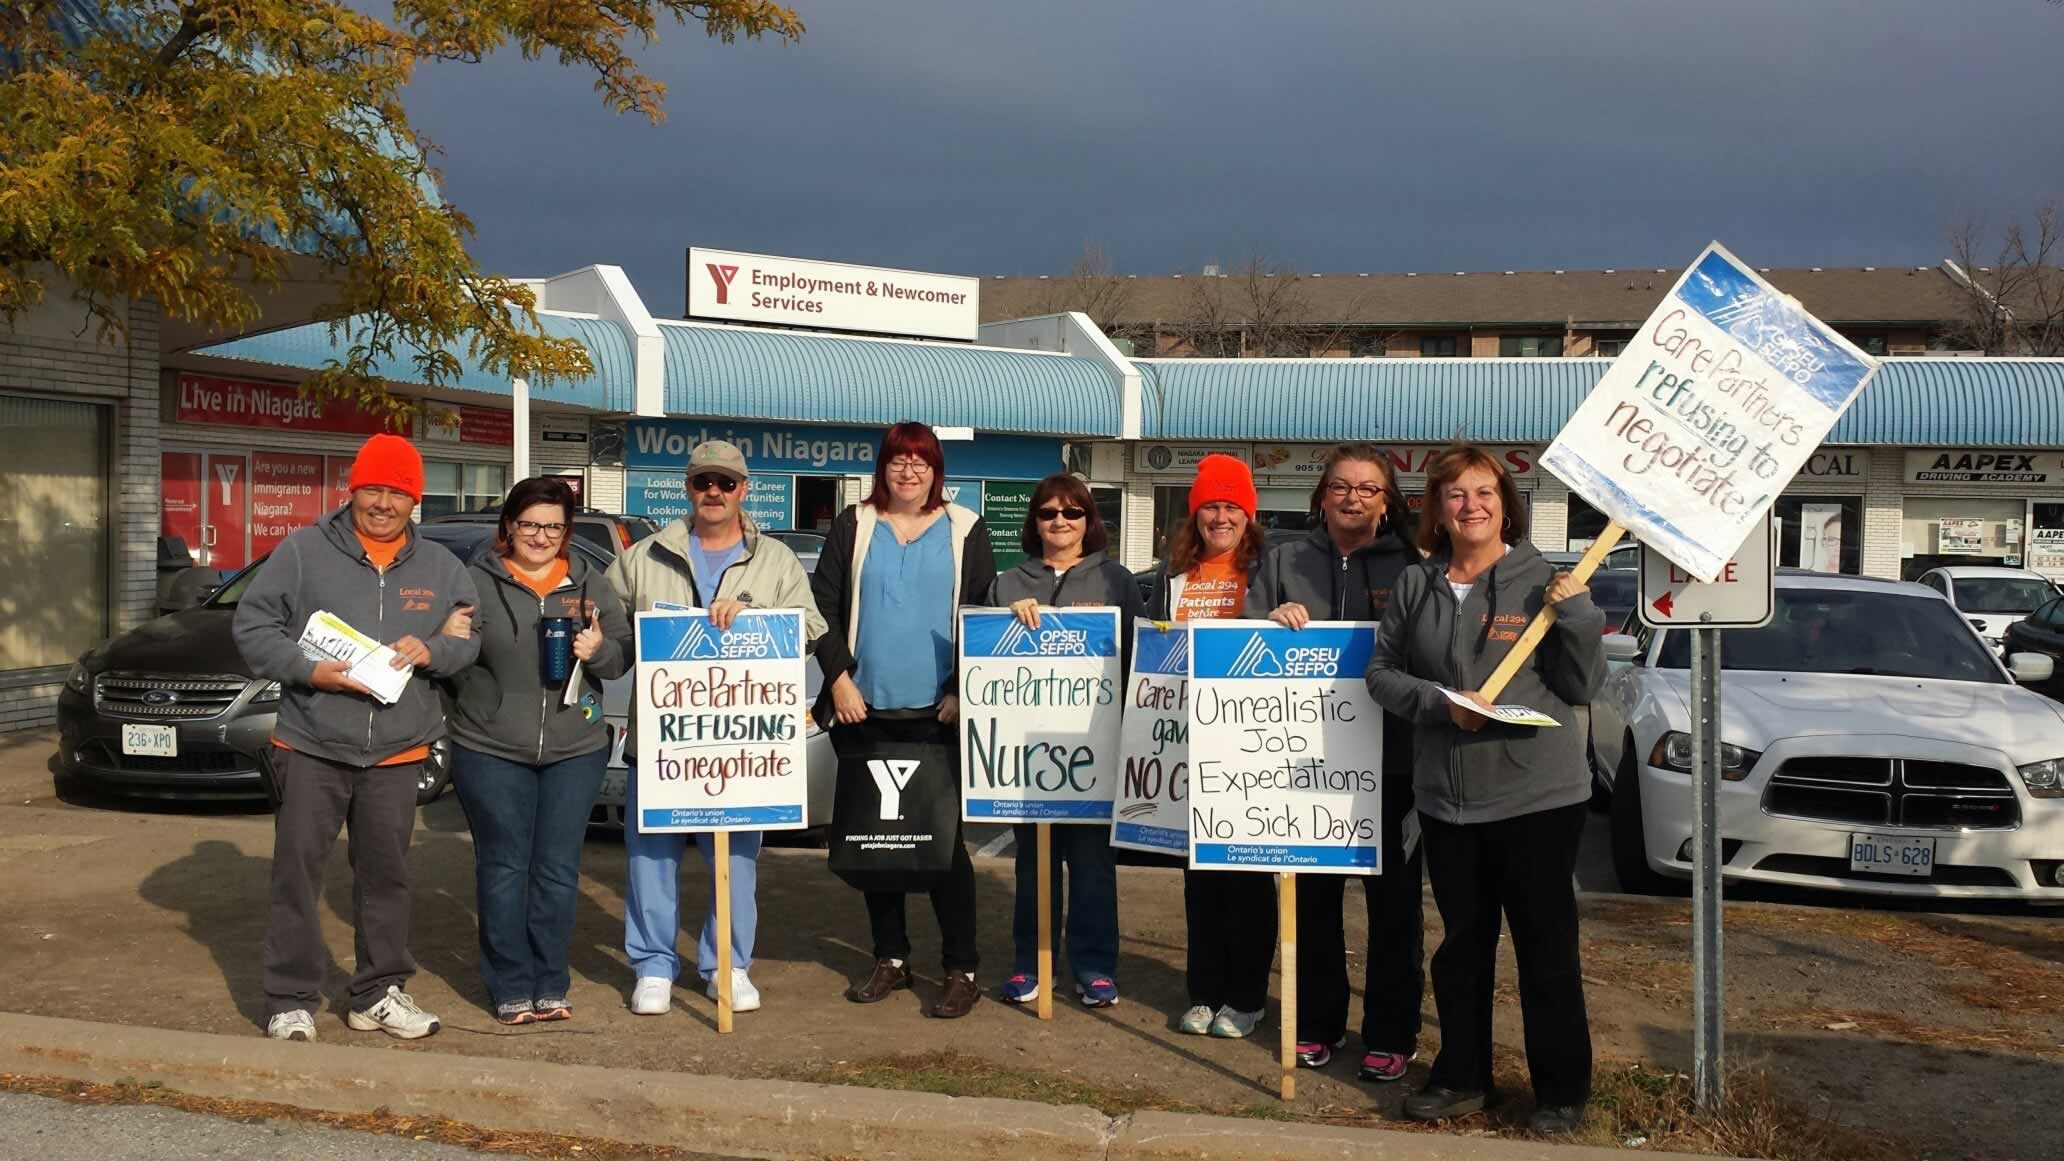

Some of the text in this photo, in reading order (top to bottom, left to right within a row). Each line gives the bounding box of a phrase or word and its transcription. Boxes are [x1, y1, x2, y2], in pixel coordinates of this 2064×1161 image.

[751, 268, 967, 306] Employment & Newcomer
[751, 291, 824, 314] Services
[180, 382, 321, 424] Live in Niagara
[1634, 359, 1780, 480] refusing to
[762, 431, 874, 467] Niagara
[253, 460, 315, 477] Are you a new
[1295, 464, 1314, 472] 905
[1930, 453, 2038, 471] AAPEX
[1919, 472, 2041, 482] DRIVING ACADEMY
[254, 481, 311, 497] immigrant to
[644, 488, 687, 500] for Work
[755, 481, 785, 491] Career
[985, 493, 1018, 502] Contact
[254, 502, 292, 518] Niagara?
[254, 523, 268, 536] We
[270, 526, 285, 536] can
[2037, 530, 2064, 539] AAPE
[1670, 562, 1738, 583] LE
[1184, 579, 1238, 591] Local 294
[1179, 597, 1235, 608] Patients
[1188, 608, 1220, 618] before
[1481, 614, 1527, 623] Lcal 294
[720, 631, 769, 646] OPSEU
[1039, 630, 1088, 642] OPSEU
[719, 645, 768, 658] SEFPO
[1039, 642, 1085, 656] SEFPO
[1284, 647, 1340, 662] OPSEU
[1284, 662, 1338, 676] SEFPO
[1196, 686, 1356, 726] Unrealistic
[659, 713, 797, 743] REFUSING
[128, 731, 147, 747] 236
[1152, 718, 1188, 755] gav
[1240, 727, 1307, 753] Job
[967, 717, 1097, 792] Nurse
[656, 748, 793, 797] to negotiate
[1124, 756, 1162, 799] NO
[1199, 757, 1377, 800] Expectations
[671, 809, 704, 817] Ontario's
[1193, 804, 1374, 850] No Sick Days
[1227, 846, 1265, 854] Ontario's
[1854, 843, 1930, 865] BDLS 628
[1227, 854, 1318, 863] Le syndicat de l'Ontario
